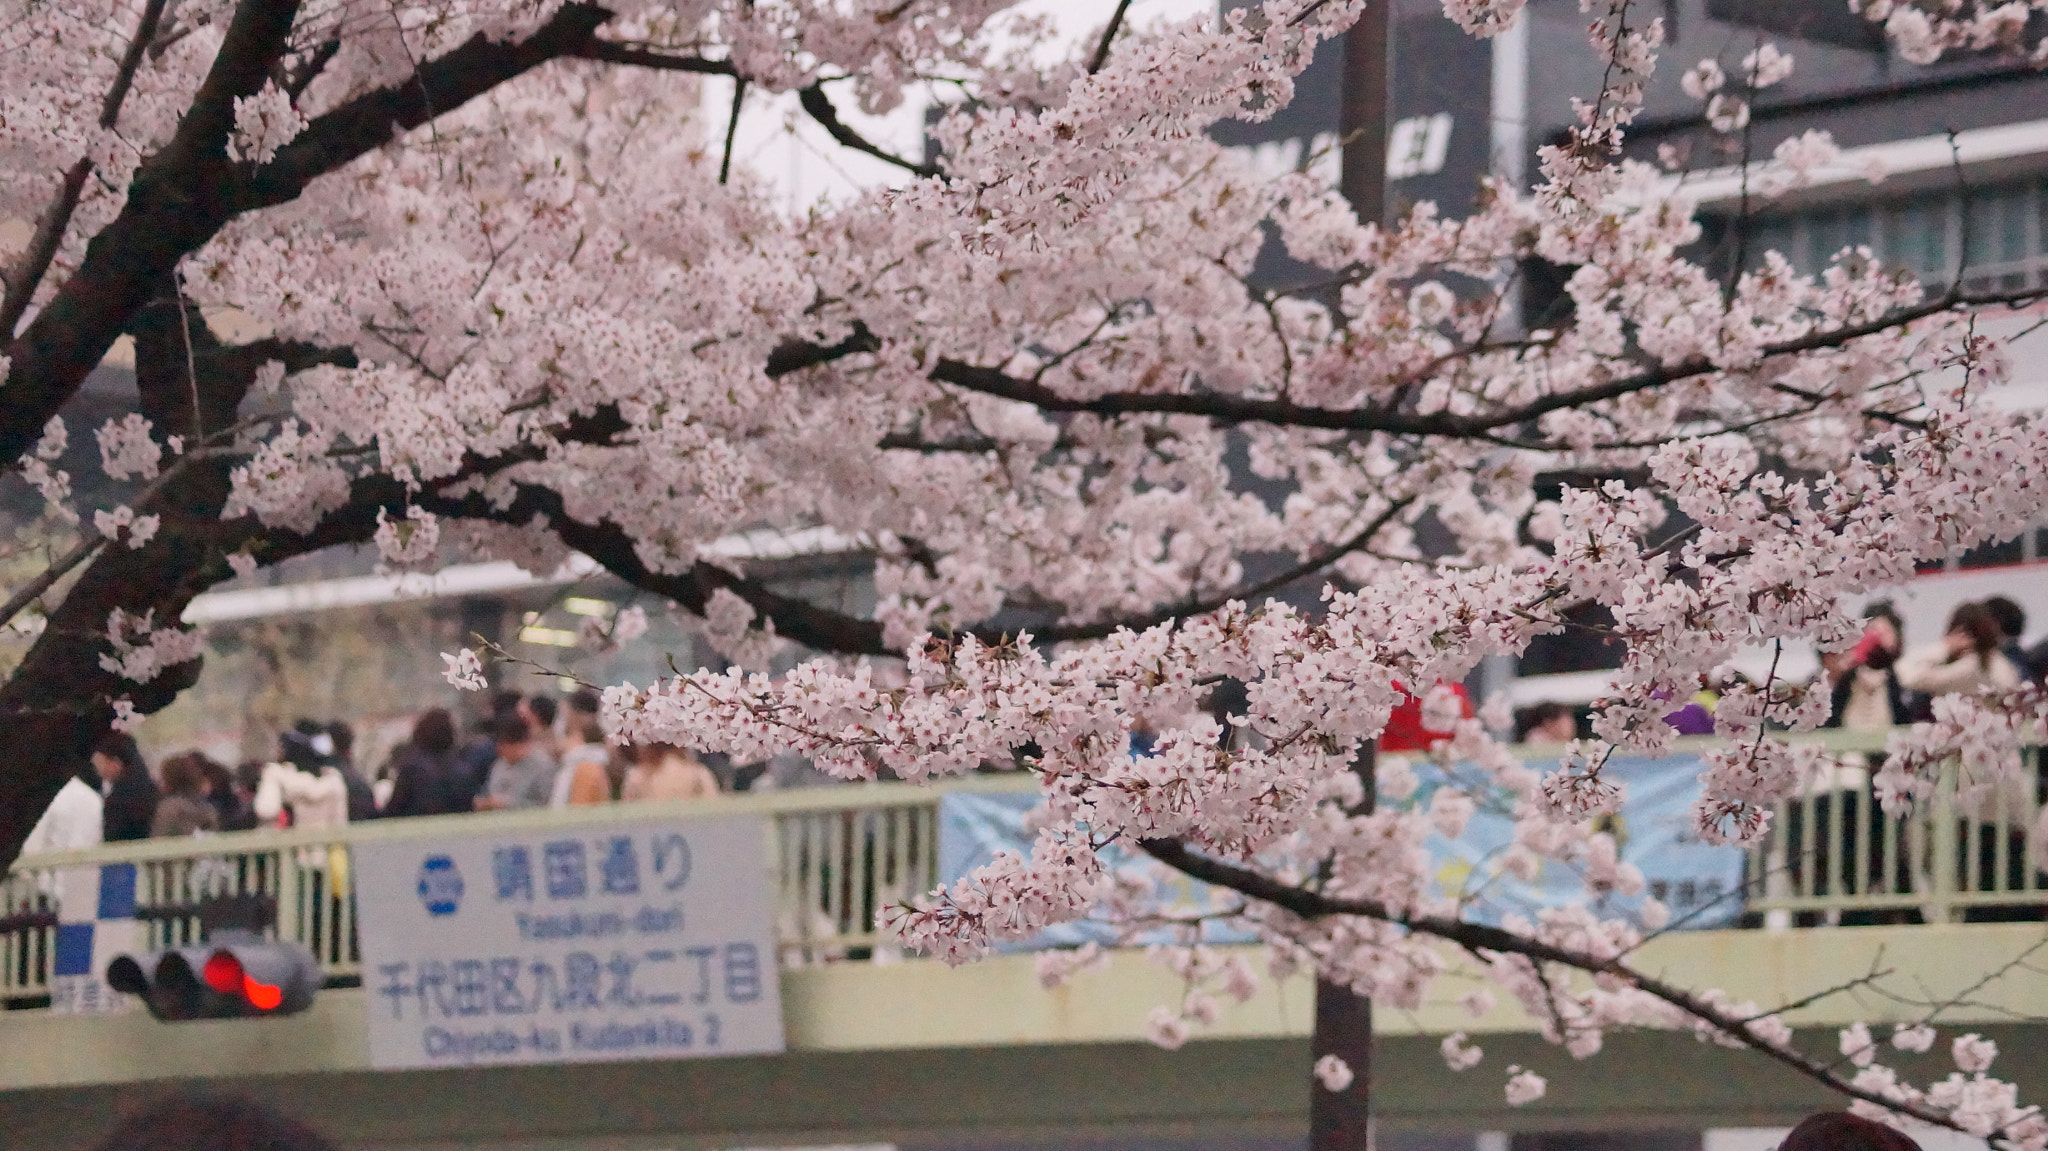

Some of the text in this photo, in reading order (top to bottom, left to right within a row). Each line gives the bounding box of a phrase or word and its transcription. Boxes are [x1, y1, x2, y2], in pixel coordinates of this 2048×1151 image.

[492, 834, 692, 901] 靖国通り
[516, 904, 684, 940] Yasukuni-dori
[379, 942, 761, 1019] 千代田区九段北二丁目
[704, 1011, 721, 1047] 2
